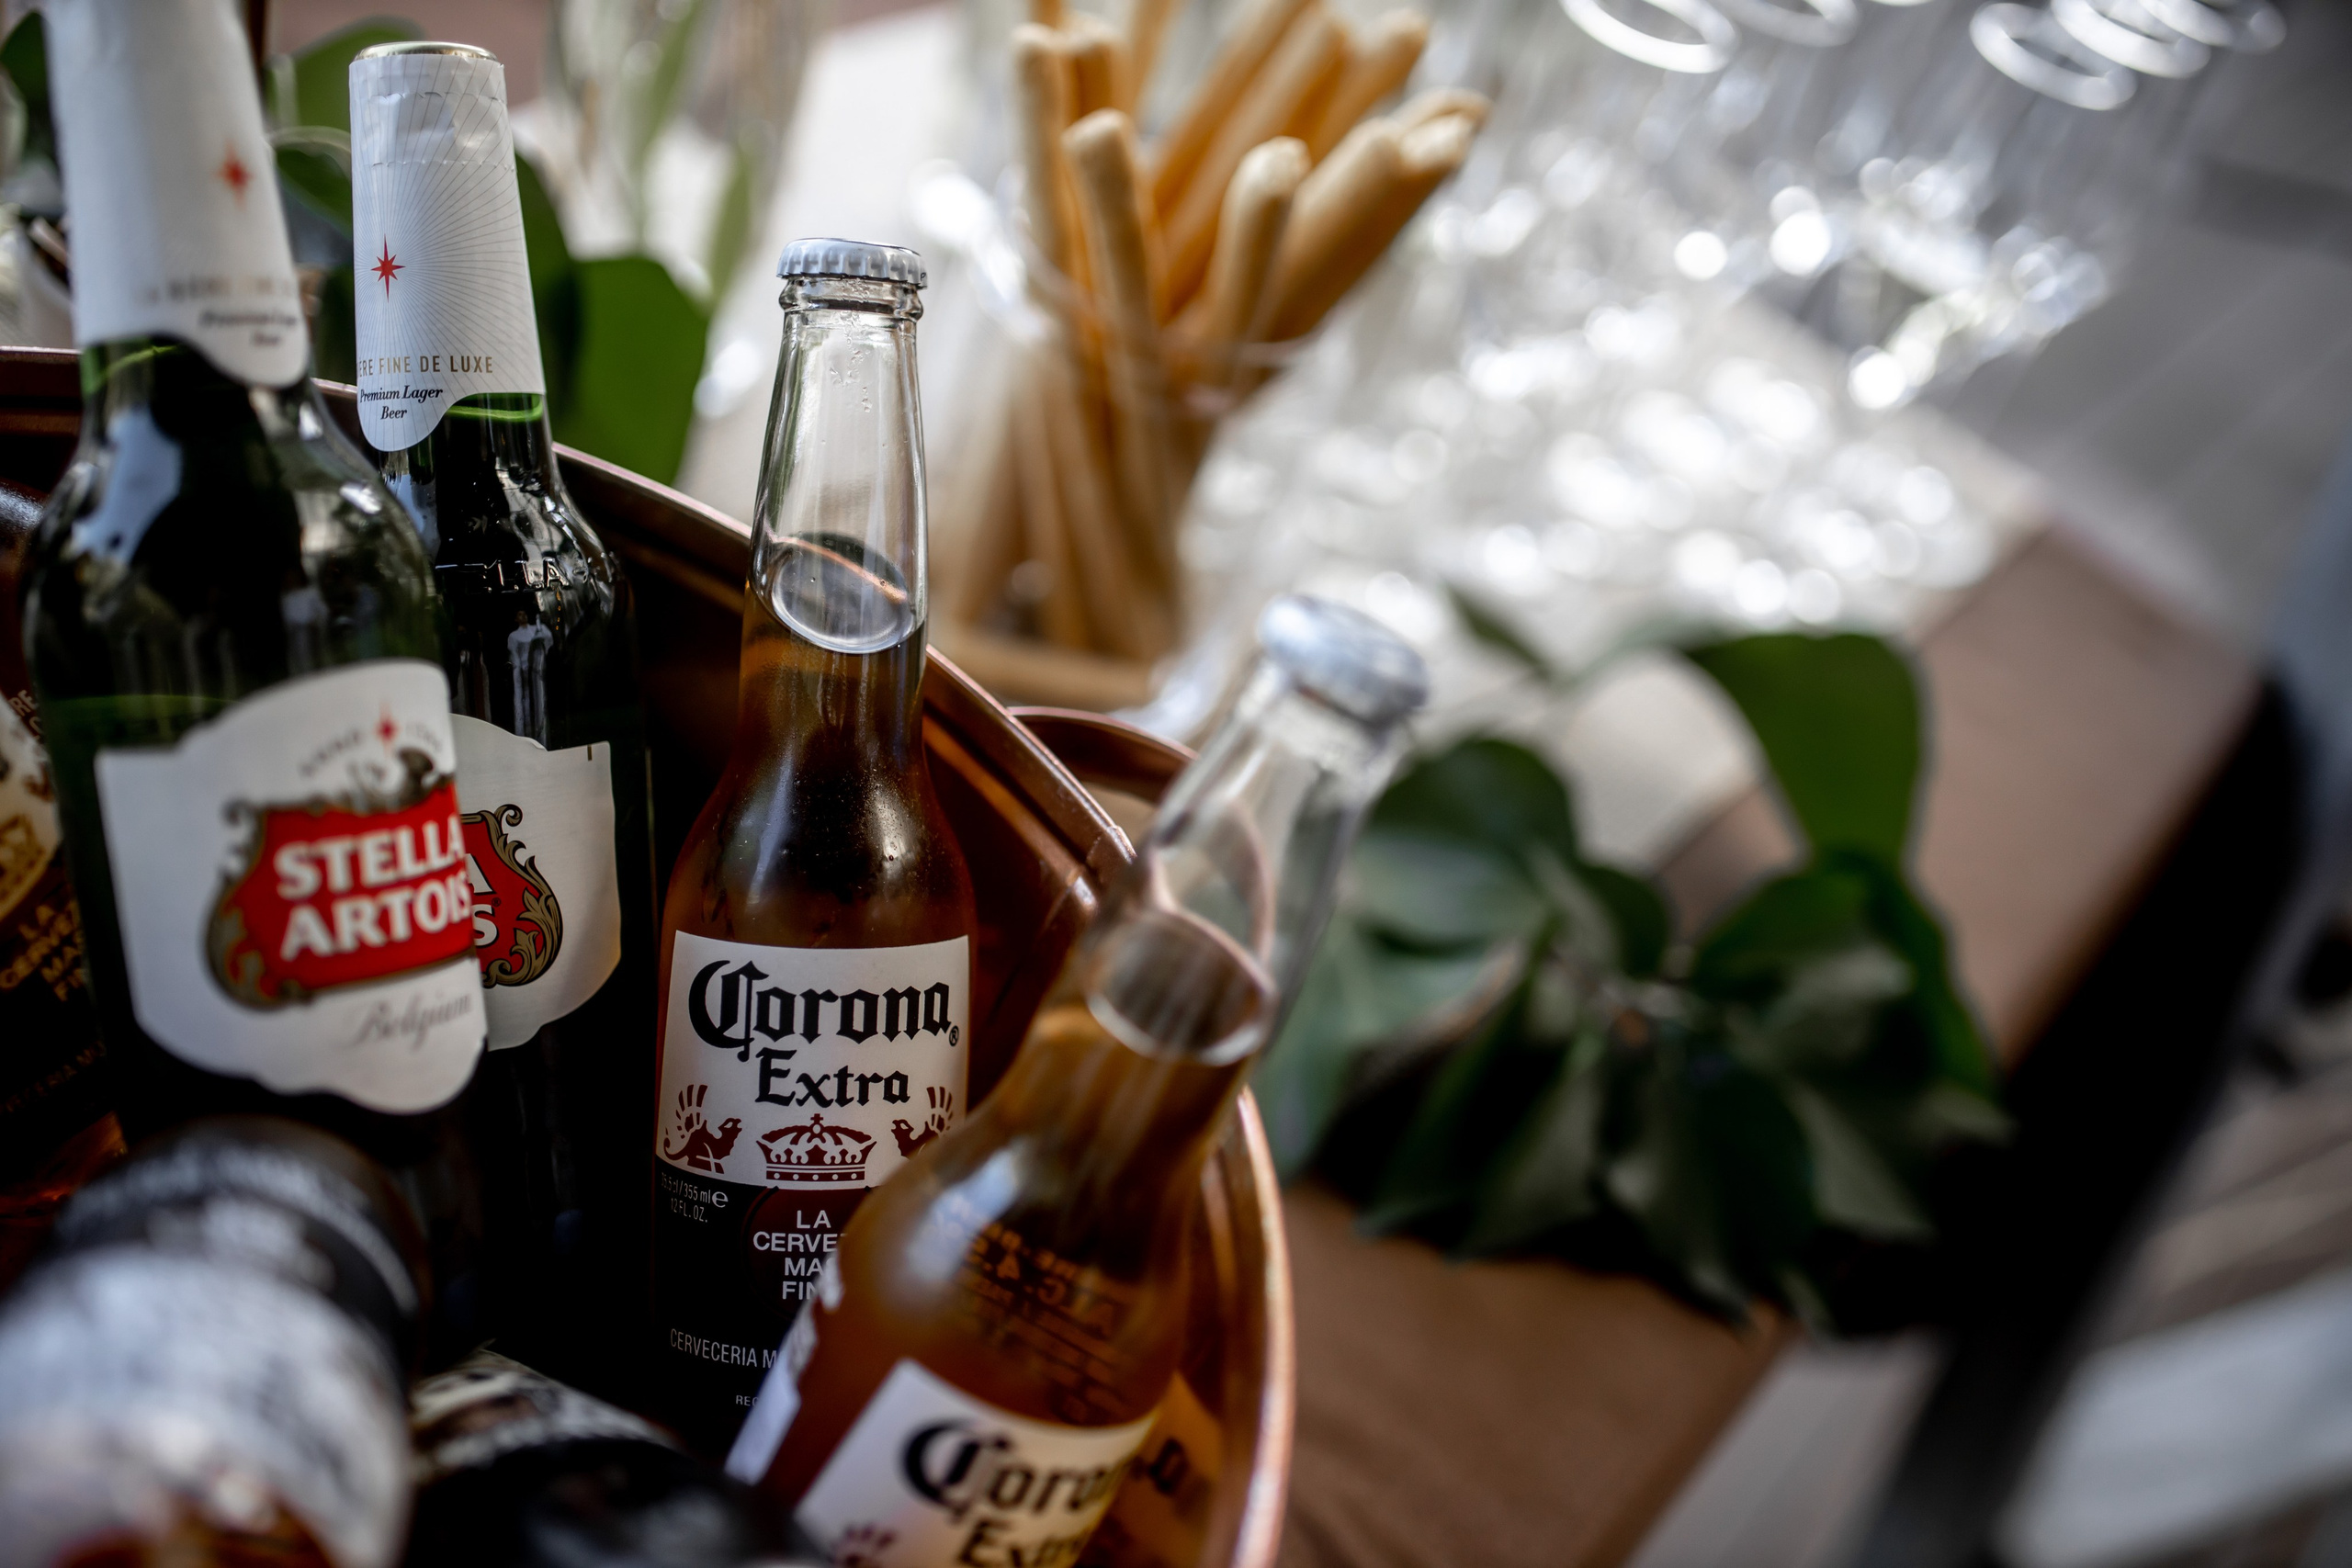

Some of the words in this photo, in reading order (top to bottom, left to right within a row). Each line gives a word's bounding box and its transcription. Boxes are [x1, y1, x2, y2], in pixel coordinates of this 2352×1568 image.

[379, 355, 412, 375] FINE
[420, 355, 441, 373] DE
[449, 355, 493, 374] LUXE
[359, 387, 401, 403] Premium
[401, 384, 444, 404] Lager
[380, 406, 408, 420] Beer
[273, 813, 466, 900] STELLA
[278, 869, 471, 962] ARTOIS
[688, 959, 952, 1063] Corona
[753, 1048, 911, 1108] Extra
[797, 1210, 831, 1229] LA
[752, 1231, 848, 1253] CERVE
[670, 1328, 758, 1368] CERVECERIA
